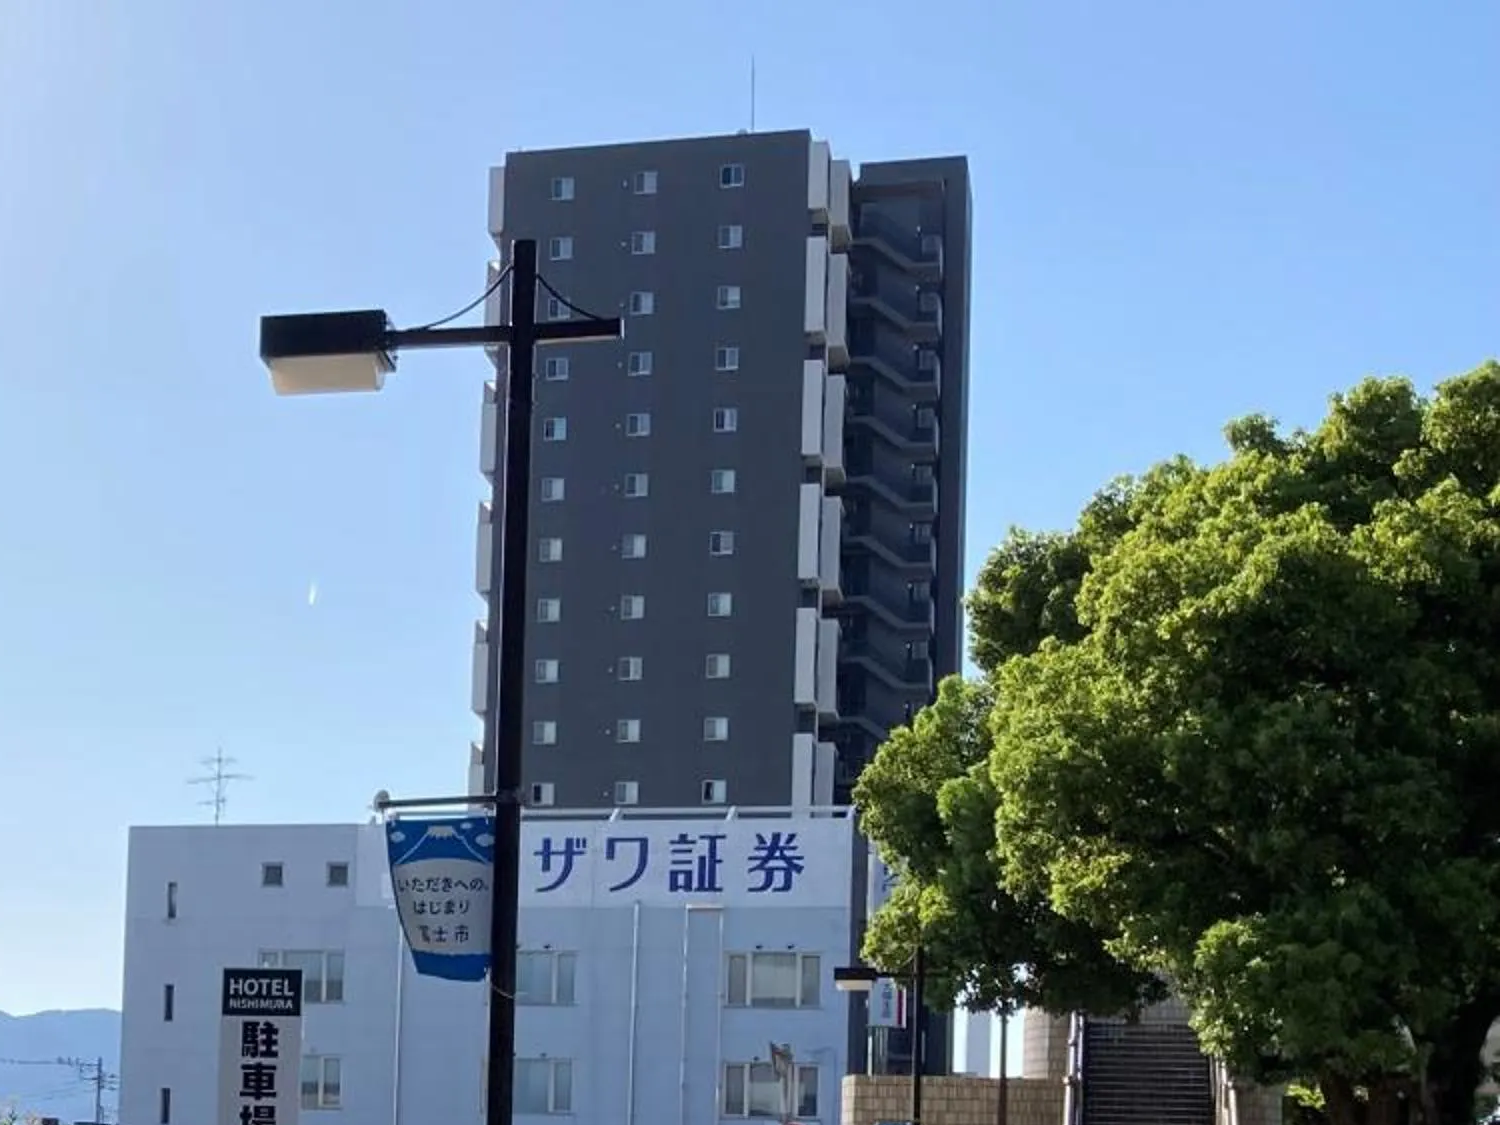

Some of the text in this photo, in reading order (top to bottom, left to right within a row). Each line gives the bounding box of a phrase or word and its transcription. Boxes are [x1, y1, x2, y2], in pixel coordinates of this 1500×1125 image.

[533, 832, 805, 893] ザワ証券
[413, 899, 470, 915] はじまり
[229, 978, 295, 996] HOTEL
[229, 997, 293, 1009] NISHIMURA
